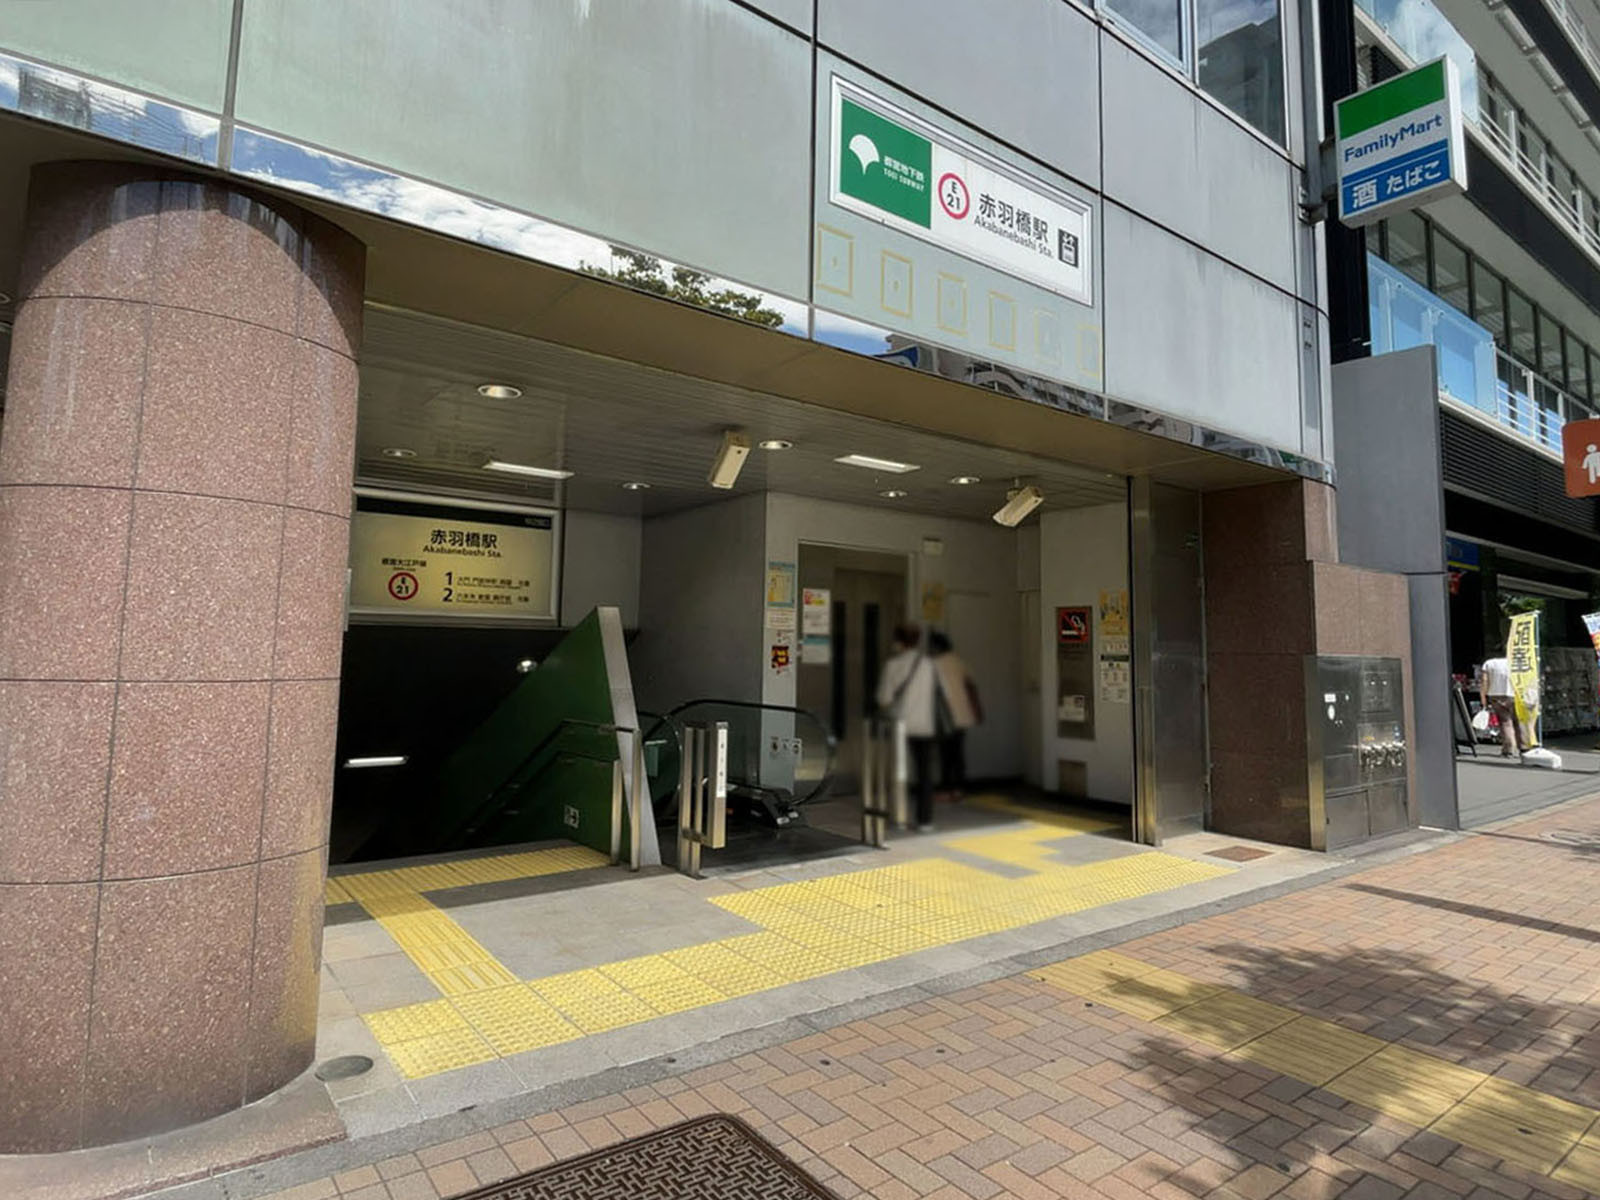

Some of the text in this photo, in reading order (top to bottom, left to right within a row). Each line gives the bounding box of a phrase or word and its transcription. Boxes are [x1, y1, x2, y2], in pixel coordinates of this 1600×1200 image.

[1344, 114, 1443, 162] FamilyMart
[951, 181, 958, 194] E
[1352, 160, 1442, 209] 酒 たばこ
[946, 193, 961, 210] 21
[979, 193, 1049, 243] 赤羽橋駅
[974, 215, 1037, 251] Akabanebashi
[1037, 242, 1055, 259] Sta.
[430, 529, 498, 549] 赤羽橋駅
[444, 571, 453, 586] 1
[395, 585, 410, 595] 21
[442, 587, 453, 602] 2
